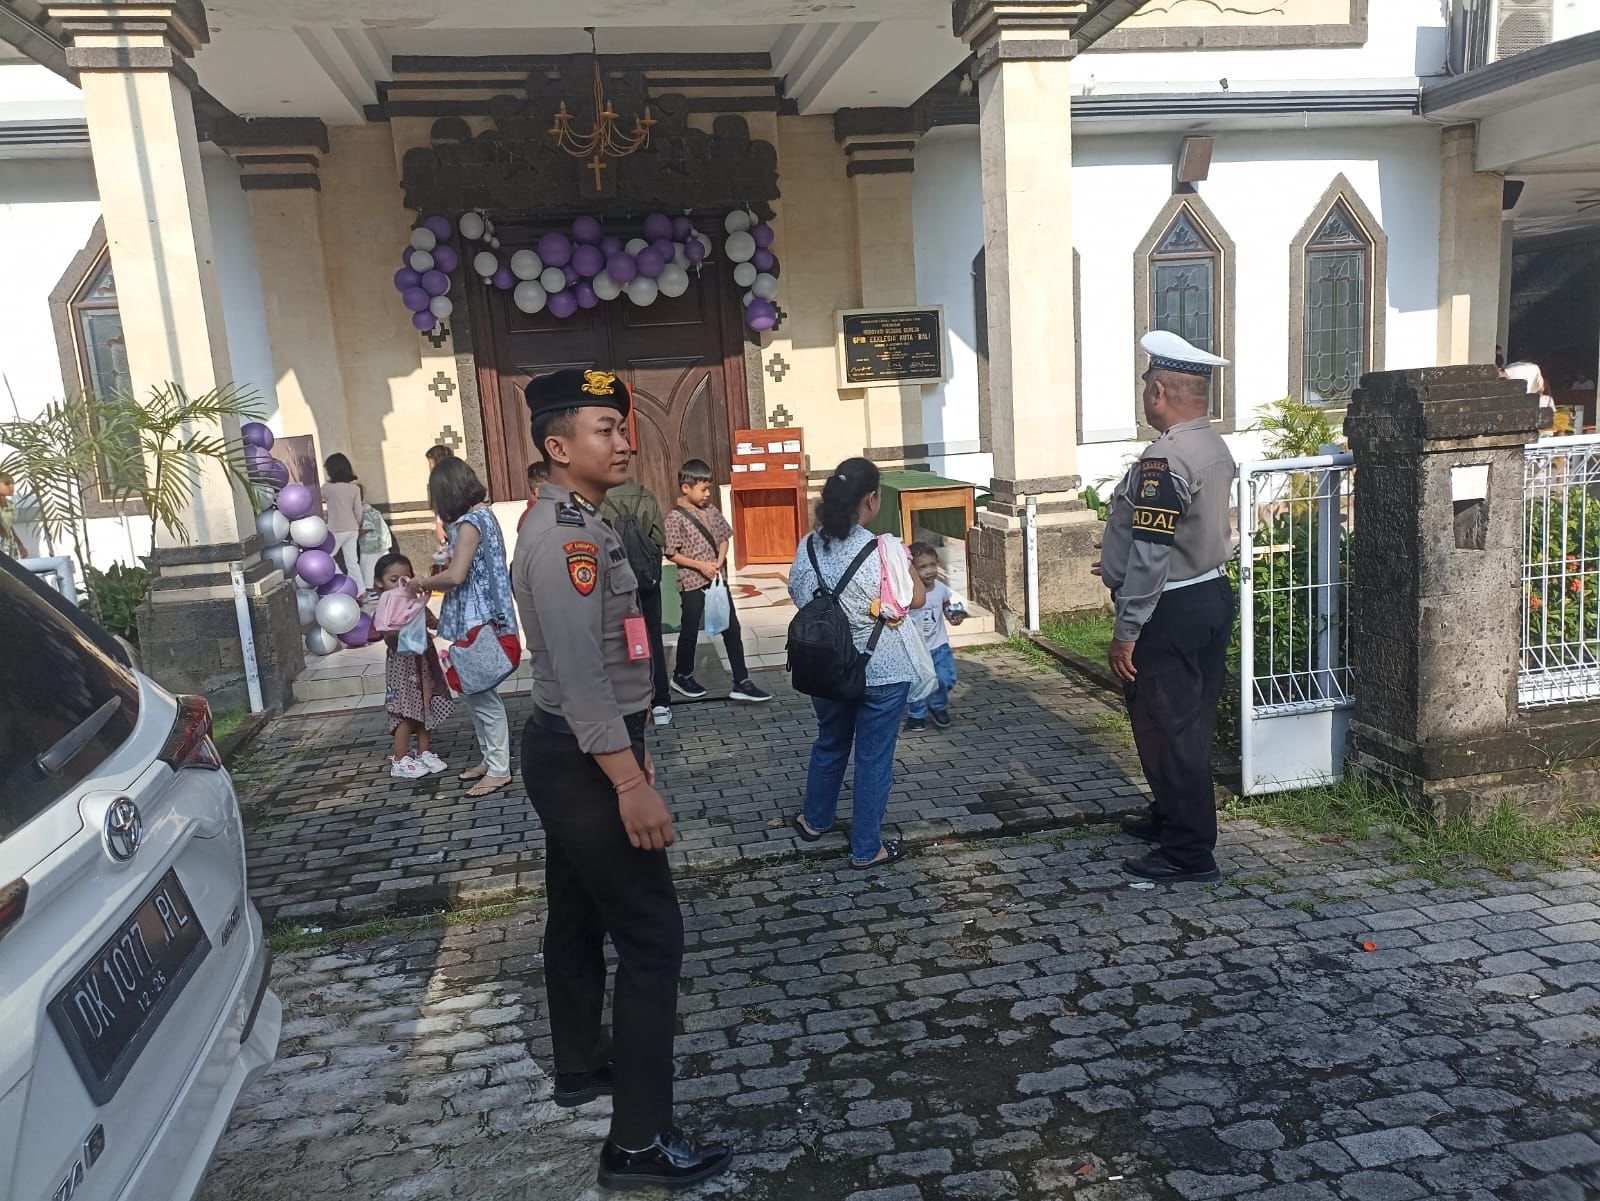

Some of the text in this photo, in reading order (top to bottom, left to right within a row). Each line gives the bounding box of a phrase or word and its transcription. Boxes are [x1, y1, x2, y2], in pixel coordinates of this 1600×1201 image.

[74, 888, 189, 1038] DK 1077 PL
